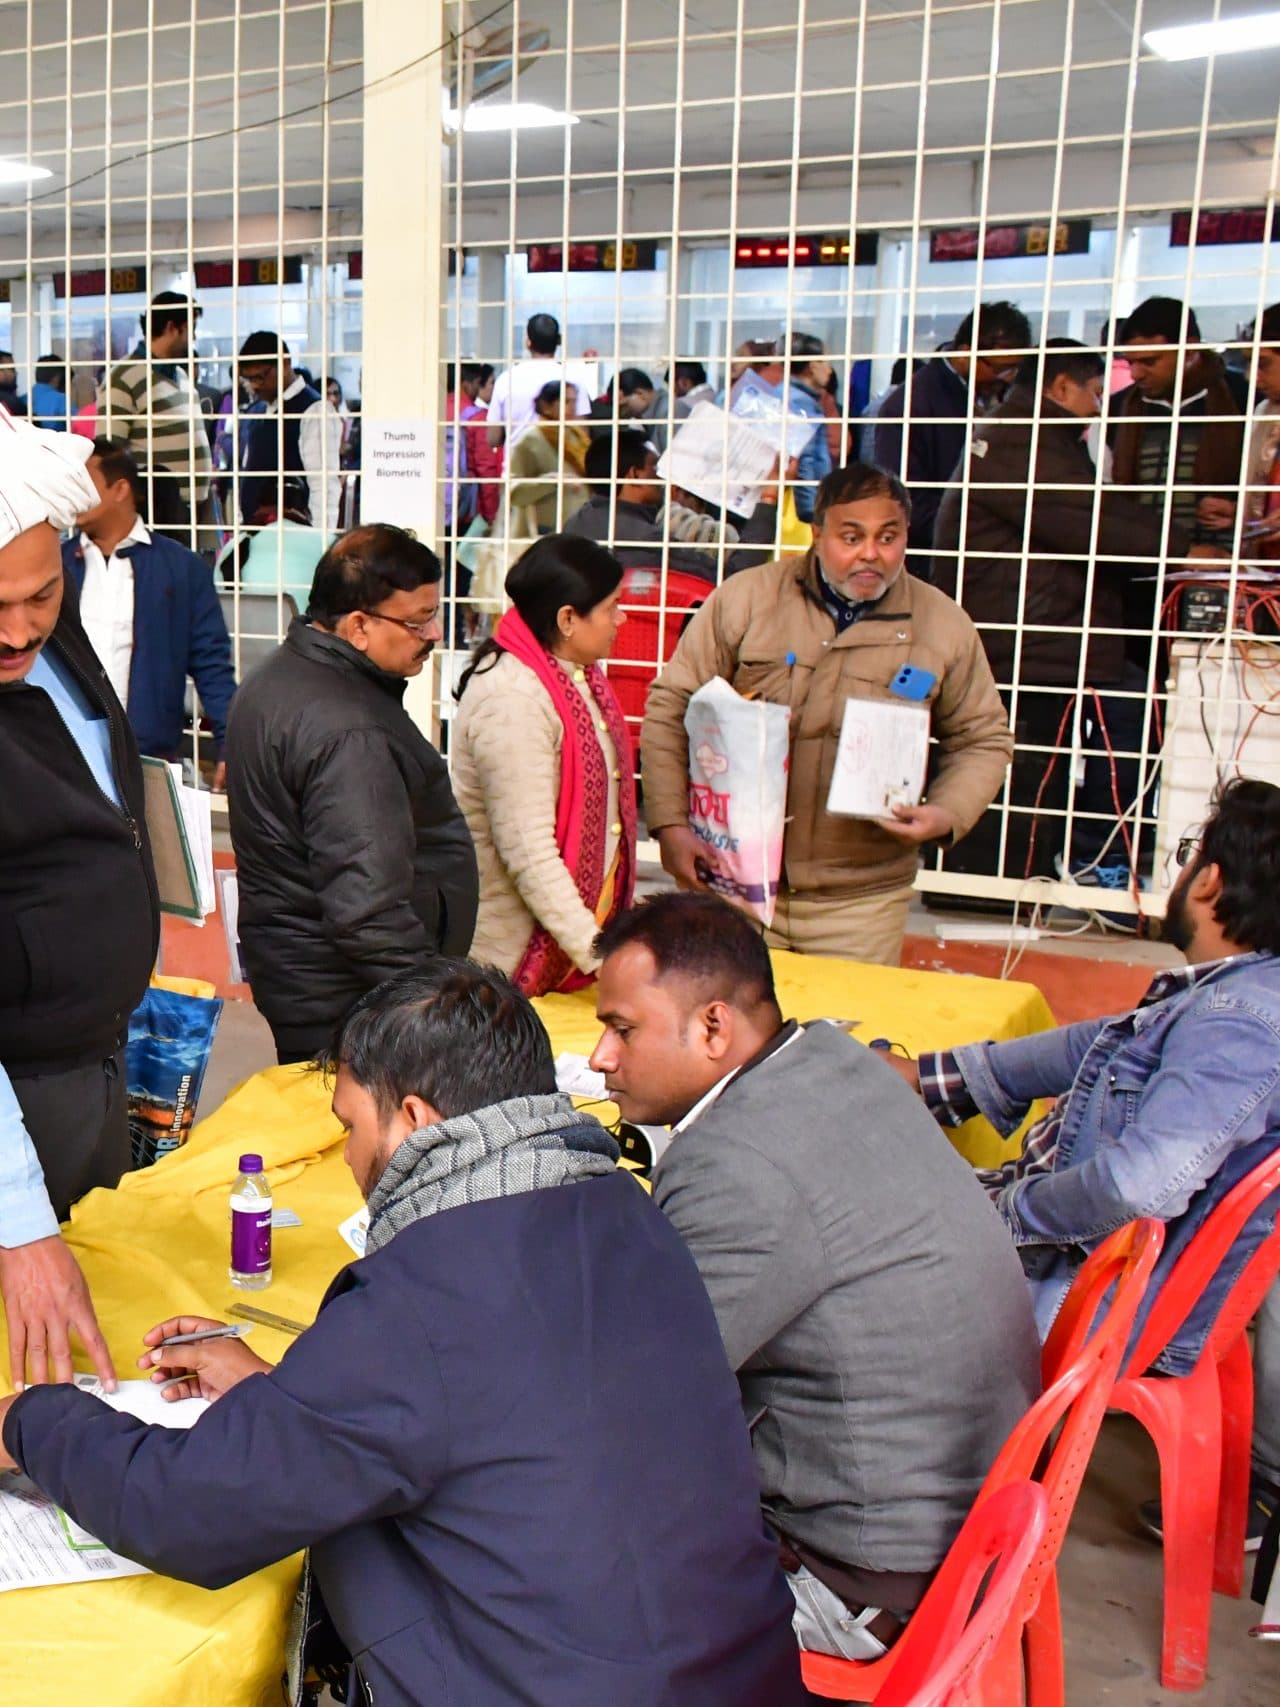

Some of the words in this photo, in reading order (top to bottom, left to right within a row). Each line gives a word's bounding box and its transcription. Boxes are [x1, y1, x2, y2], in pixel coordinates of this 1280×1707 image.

[383, 432, 416, 441] Thumb
[373, 450, 425, 459] Impression
[376, 468, 421, 477] Biometric
[170, 1075, 191, 1132] innovation
